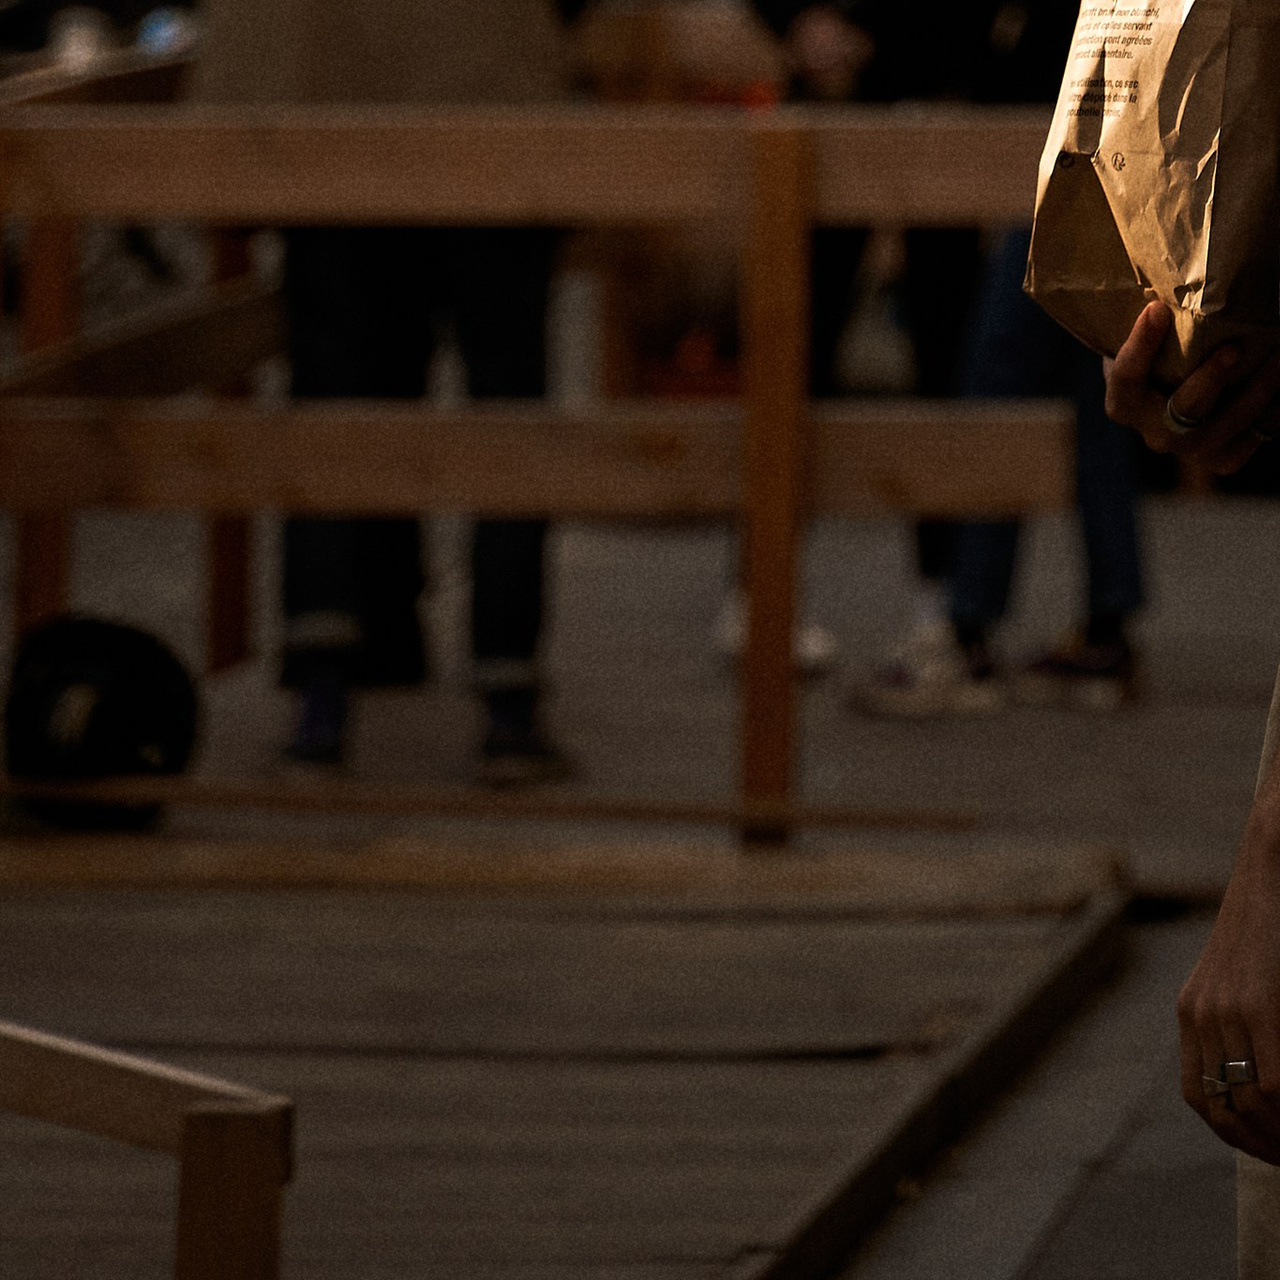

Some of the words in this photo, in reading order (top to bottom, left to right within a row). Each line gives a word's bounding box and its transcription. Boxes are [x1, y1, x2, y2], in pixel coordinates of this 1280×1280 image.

[1115, 9, 1130, 17] non
[1123, 22, 1153, 31] servant
[1121, 35, 1153, 46] agréées
[1124, 79, 1139, 88] sac
[1128, 93, 1138, 104] la
